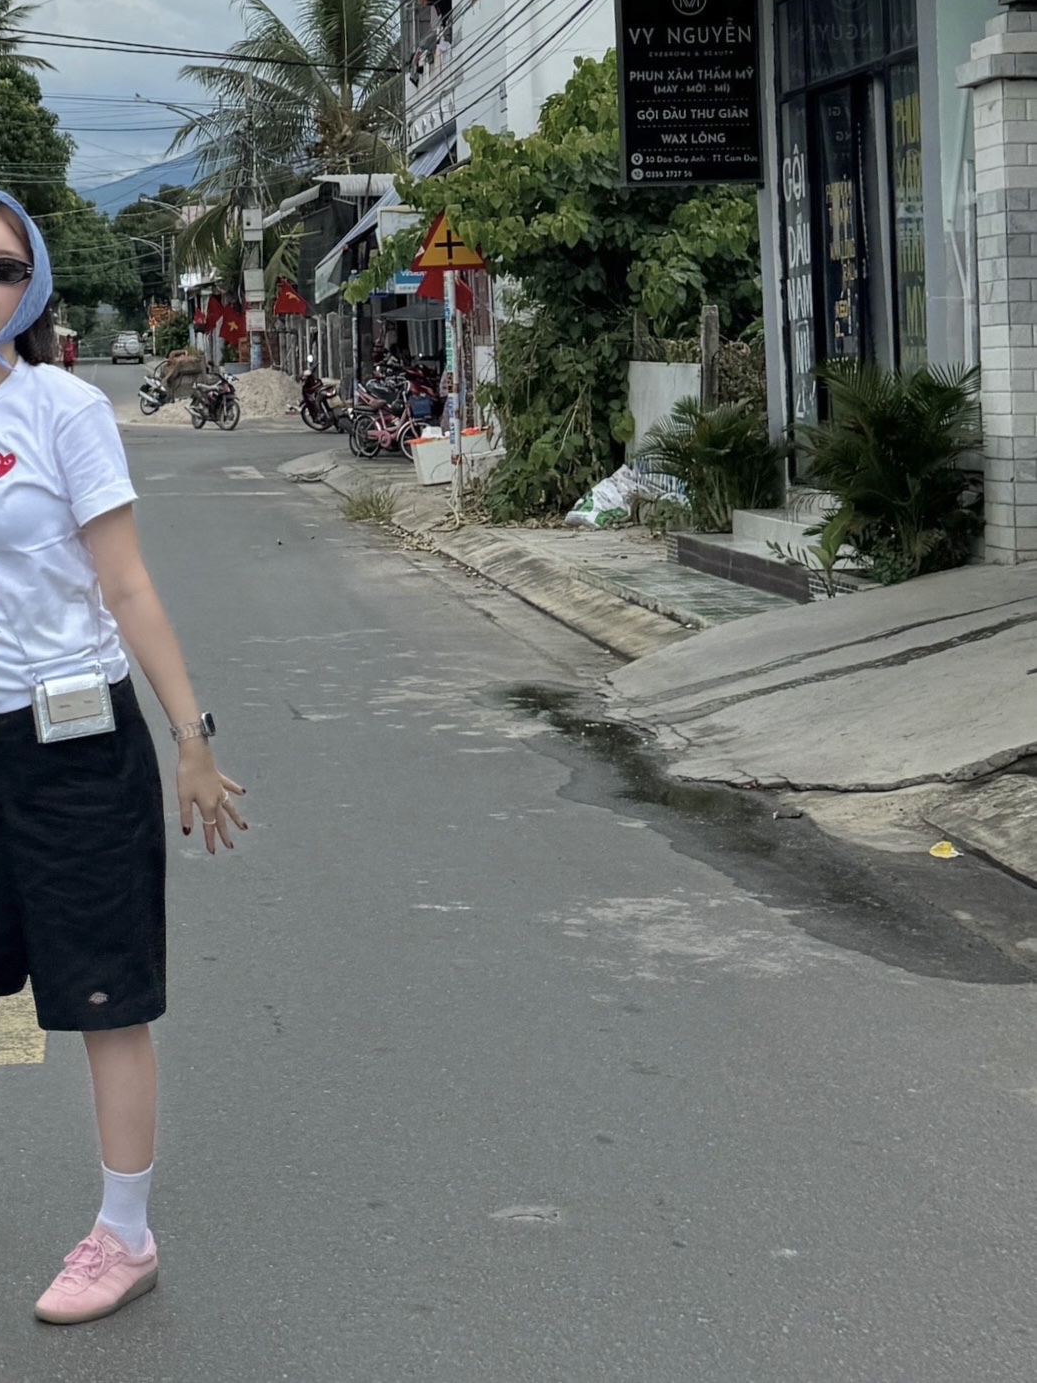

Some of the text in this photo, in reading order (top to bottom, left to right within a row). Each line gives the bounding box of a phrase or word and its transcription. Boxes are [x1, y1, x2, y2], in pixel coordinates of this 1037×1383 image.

[629, 17, 752, 45] VY NGUYỄN
[629, 70, 663, 82] PHUN
[637, 107, 659, 122] GỘI
[690, 108, 716, 119] THƯ
[661, 131, 726, 145] WAX LÔNG
[783, 143, 805, 207] GỘI
[787, 274, 813, 321] NAM
